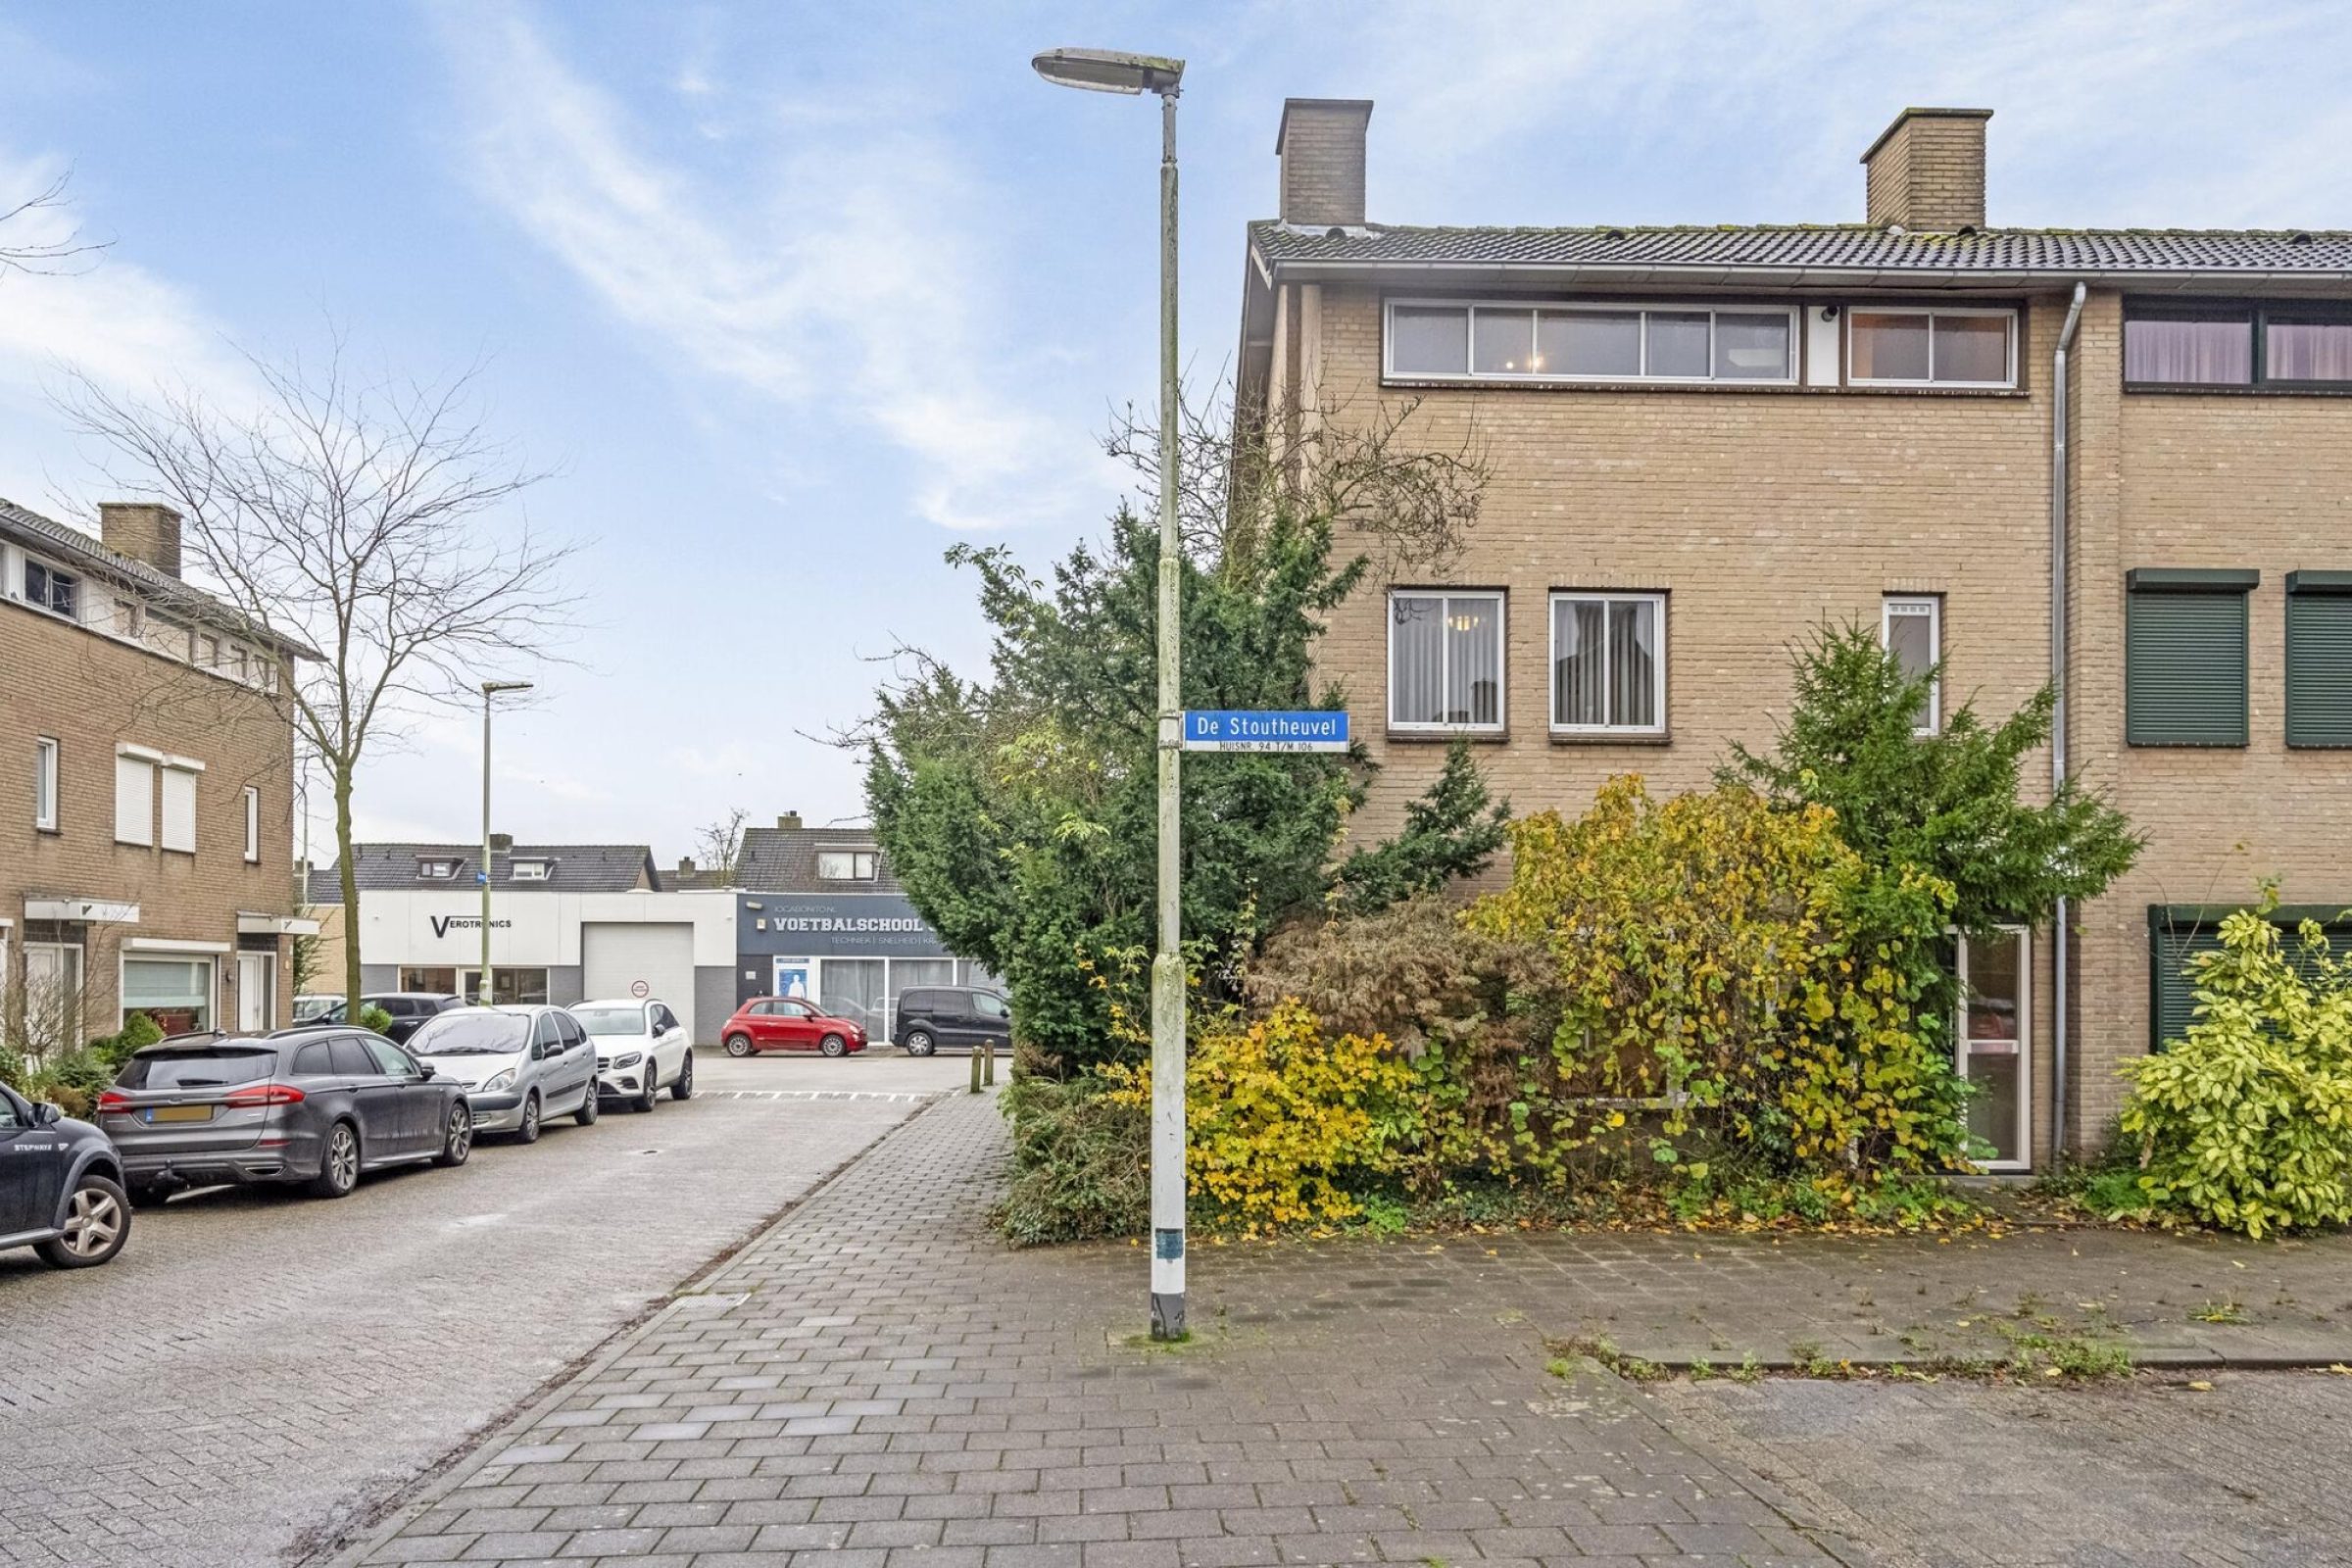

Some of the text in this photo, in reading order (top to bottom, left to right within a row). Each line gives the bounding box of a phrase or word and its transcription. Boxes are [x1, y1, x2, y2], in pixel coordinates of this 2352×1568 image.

[1197, 716, 1336, 735] De Stoutheuvel
[1258, 742, 1271, 752] 94
[1276, 742, 1294, 752] T/M
[1298, 742, 1313, 752] 106
[429, 915, 512, 938] VEROTRNICS
[773, 917, 923, 932] VOETBALSCHOOL
[878, 936, 917, 945] SNELHEID
